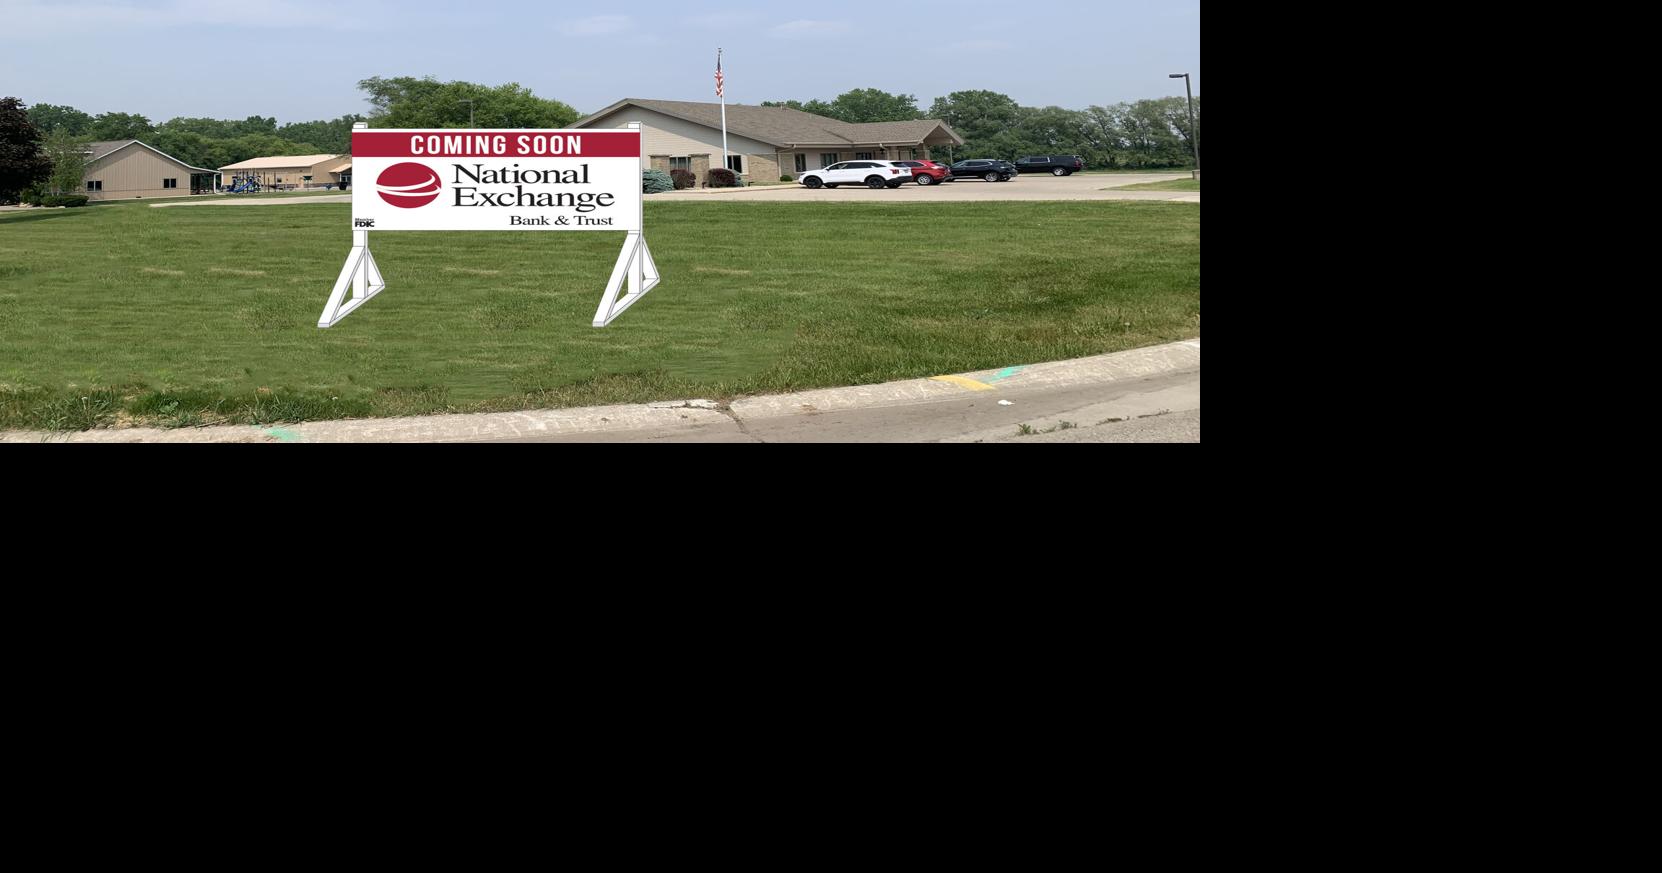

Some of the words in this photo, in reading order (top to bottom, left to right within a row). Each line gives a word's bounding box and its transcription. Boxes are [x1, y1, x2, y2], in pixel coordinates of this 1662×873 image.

[411, 135, 507, 155] COMING
[517, 135, 581, 155] SOON
[452, 163, 591, 184] National
[452, 185, 615, 213] Exchange
[510, 215, 550, 226] Bank
[554, 215, 569, 226] &
[573, 215, 613, 226] Trust
